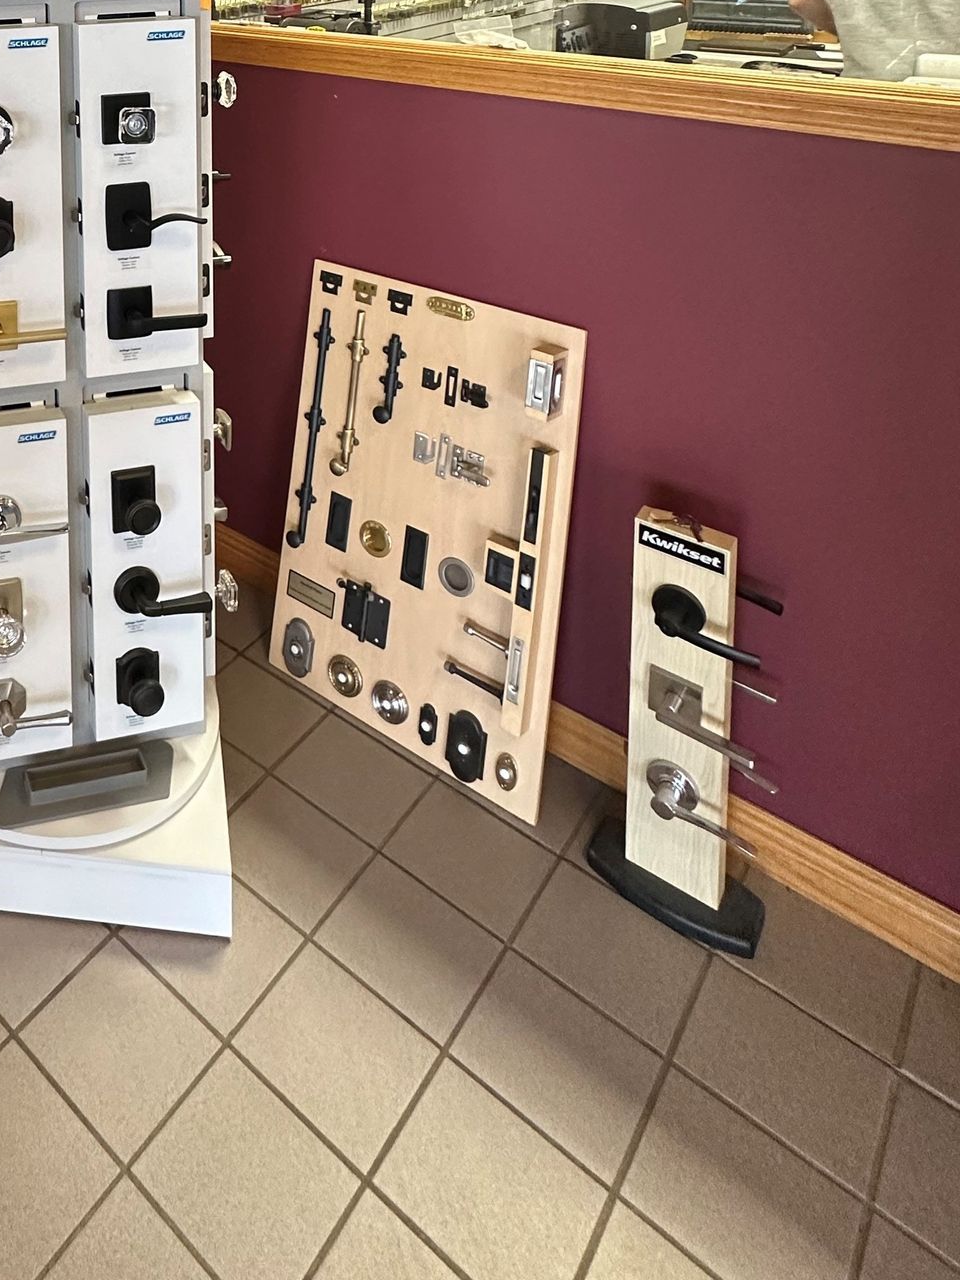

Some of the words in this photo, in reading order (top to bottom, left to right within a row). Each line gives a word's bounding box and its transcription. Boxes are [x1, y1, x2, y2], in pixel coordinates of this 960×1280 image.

[147, 30, 186, 41] SCHLAGE
[8, 38, 49, 48] SCHLAGE
[154, 413, 191, 425] SCHLAGE
[17, 431, 56, 443] SCHLAGE
[641, 530, 722, 569] Kwikset
